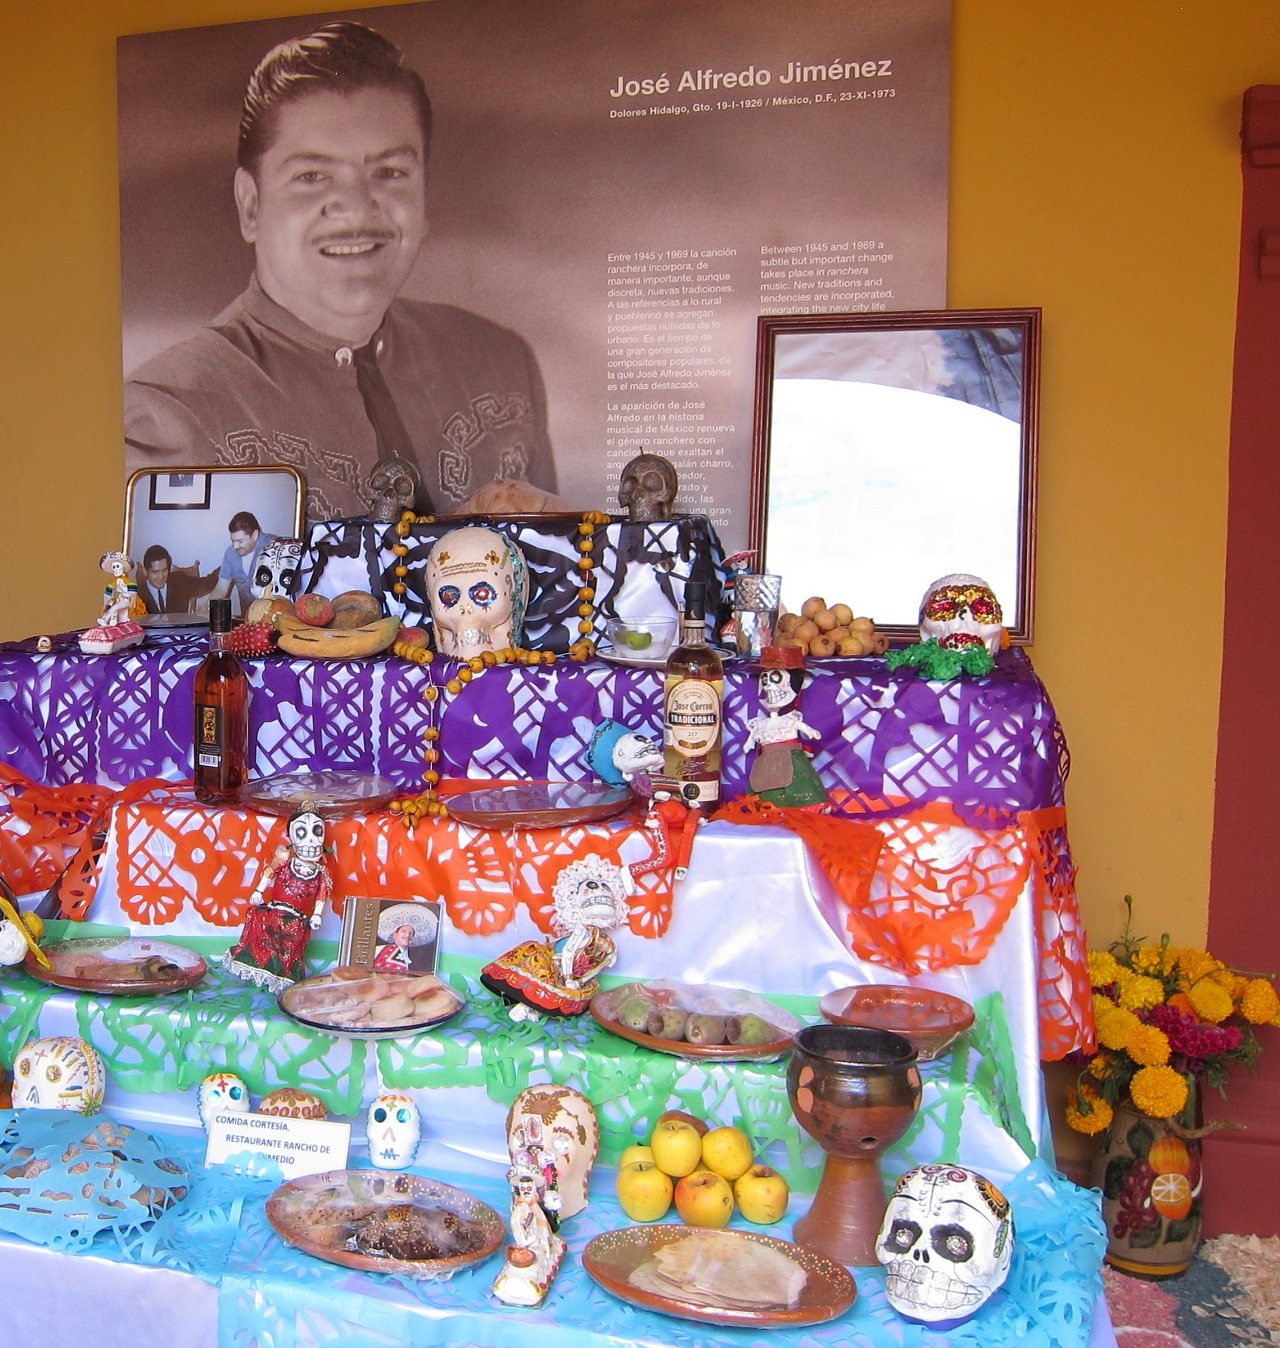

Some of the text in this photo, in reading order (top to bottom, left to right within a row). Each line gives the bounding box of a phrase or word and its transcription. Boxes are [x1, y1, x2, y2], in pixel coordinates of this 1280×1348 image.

[610, 58, 892, 98] José Alfredo Jiménez
[610, 108, 647, 118] Dolores
[650, 104, 690, 117] Hidalgo,
[693, 102, 713, 112] Gto.
[716, 98, 762, 110] 19-I-1926
[773, 96, 812, 106] México,
[815, 93, 837, 103] D.F.,
[840, 89, 896, 102] 23-XI-1973
[761, 246, 802, 255] Between
[805, 244, 827, 252] 1945
[830, 242, 848, 251] and
[852, 241, 874, 250] 1969
[608, 248, 736, 262] Entre 1945 y 1969 la canción
[761, 254, 894, 266] subtle but important change
[608, 261, 708, 274] ranchera incorpora, de
[761, 266, 868, 278] takes place in ranchera
[608, 273, 730, 285] manera importante, aunque
[761, 278, 882, 291] music. New traditions and
[608, 289, 645, 298] discreta,
[682, 285, 734, 294] tradiciones.
[761, 290, 894, 302] tendencies are incorporated,
[608, 301, 614, 309] A
[632, 298, 680, 308] referencias
[691, 298, 698, 306] lo
[701, 297, 721, 305] rural
[760, 302, 886, 314] integrating the new city life
[608, 401, 705, 412] La aparición de José
[607, 414, 640, 422] Alfredo
[658, 414, 666, 422] la
[669, 413, 704, 421] historia
[607, 424, 735, 434] musical de México renueva
[607, 436, 715, 447] el género ranchero con
[671, 715, 715, 724] TRADICIONAL
[356, 903, 374, 964] Brillantes
[216, 1116, 290, 1131] COMIDA CORTESÍA.
[226, 1134, 331, 1154] RESTAURANTE RANCHO DE
